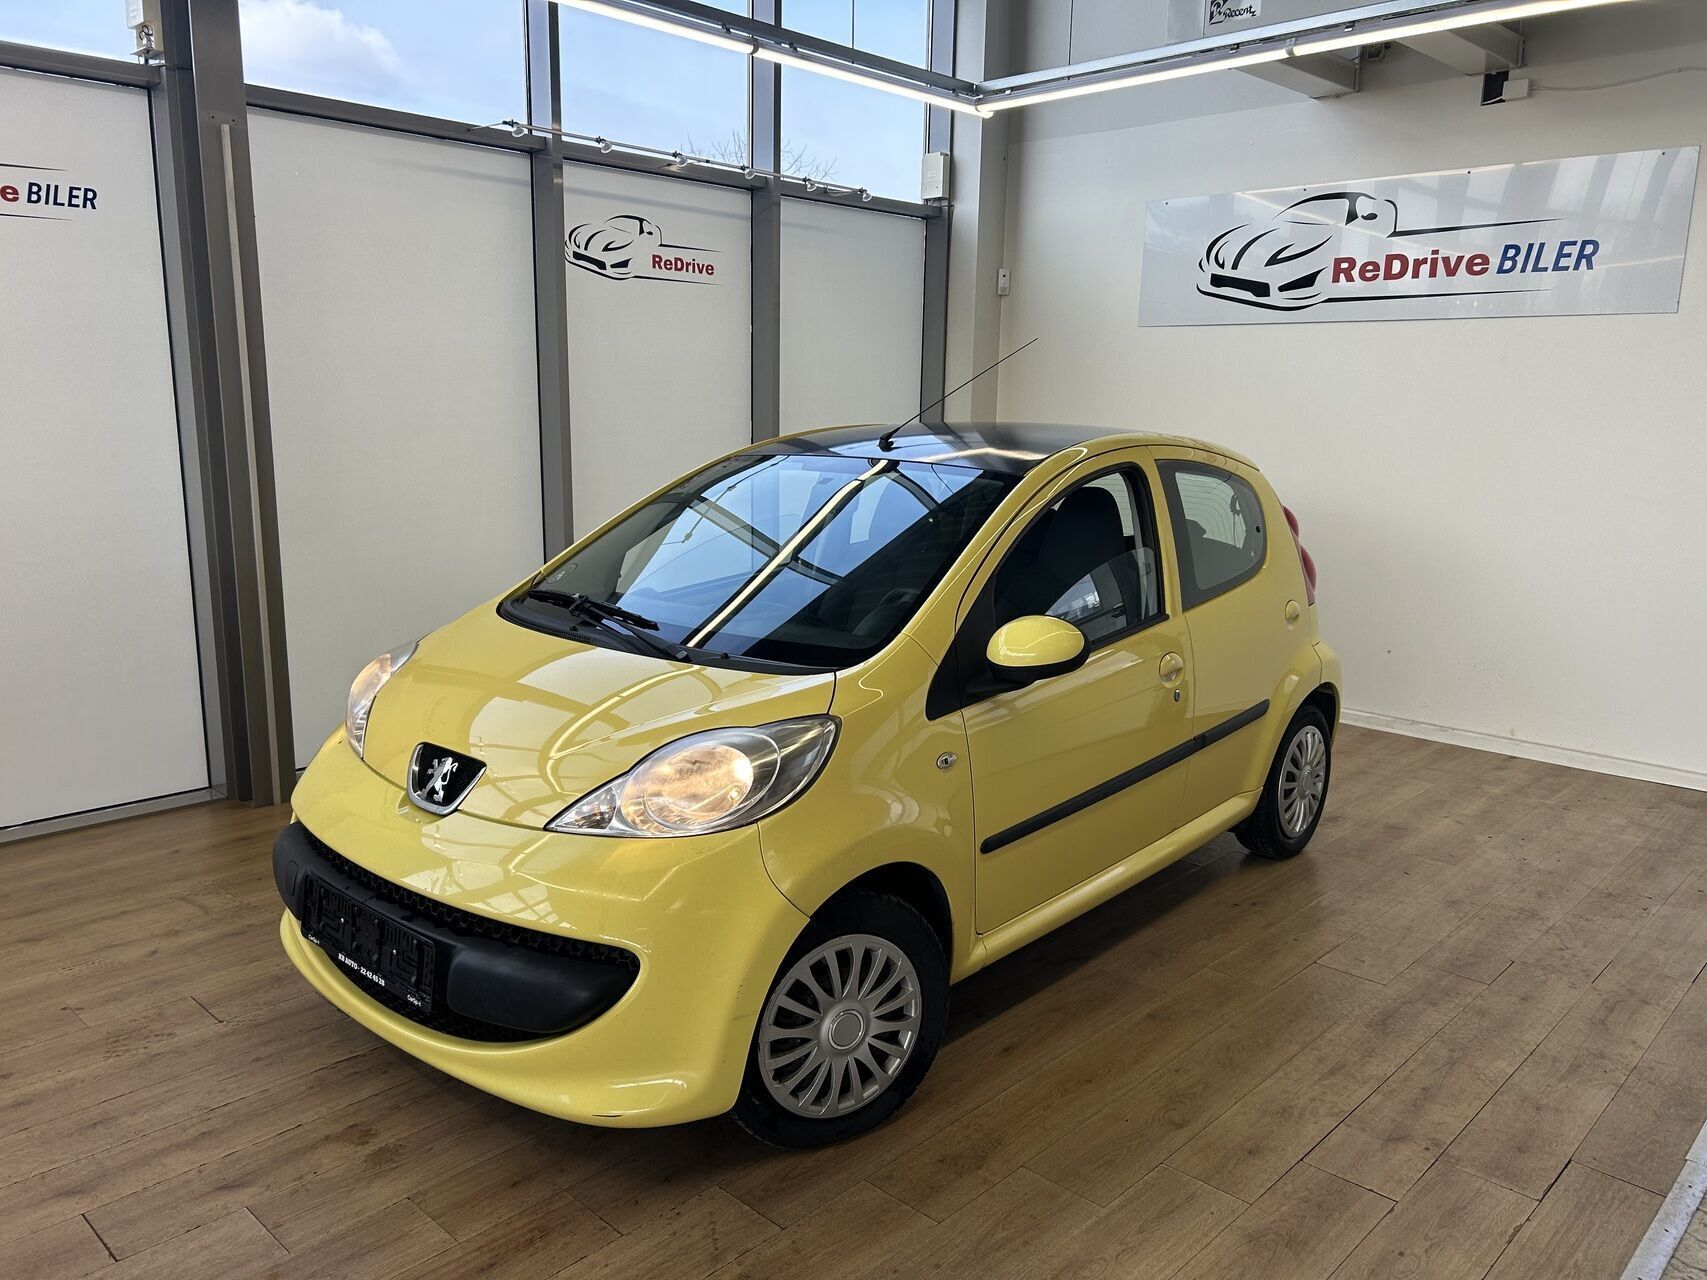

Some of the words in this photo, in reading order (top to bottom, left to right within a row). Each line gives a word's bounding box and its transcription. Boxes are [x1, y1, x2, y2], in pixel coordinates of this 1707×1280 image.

[27, 182, 97, 210] BILER
[651, 254, 715, 276] ReDrive
[1331, 249, 1491, 284] ReDrive
[1496, 239, 1600, 275] BILER
[345, 957, 358, 970] AUTO
